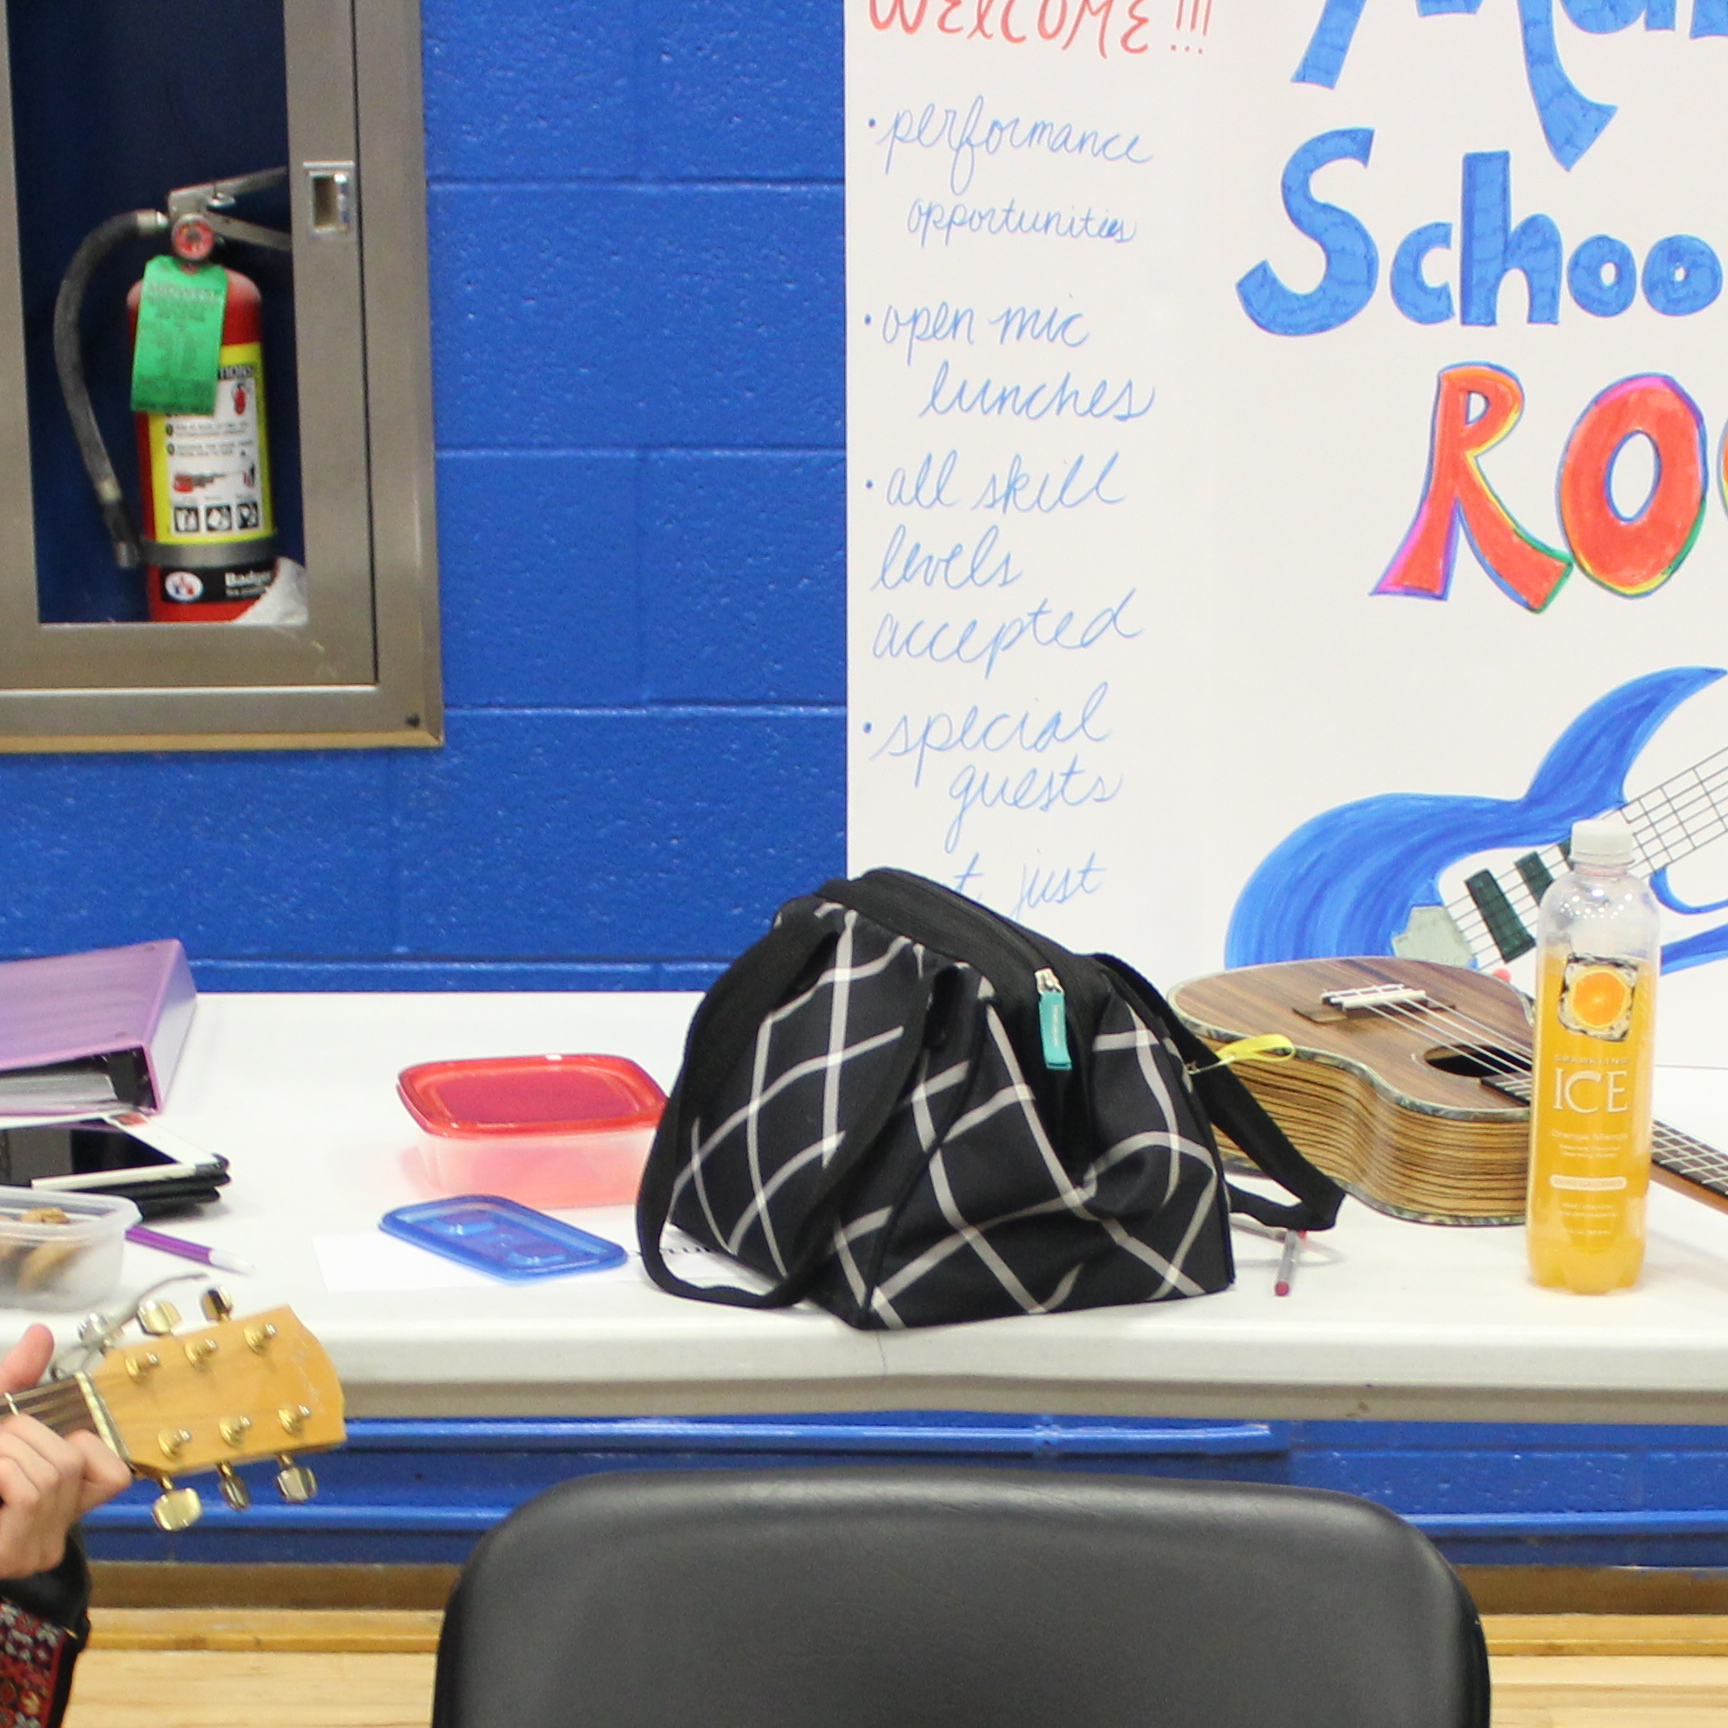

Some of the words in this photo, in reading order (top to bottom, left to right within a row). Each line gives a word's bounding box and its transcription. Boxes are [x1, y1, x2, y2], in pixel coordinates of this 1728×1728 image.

[875, 95, 1154, 195] performance
[906, 199, 1137, 248] opportunities
[880, 302, 976, 365] open
[989, 294, 1091, 348] mic
[917, 360, 1156, 423] lunches
[885, 449, 960, 508] all
[969, 451, 1126, 512] skill
[870, 525, 1024, 591] levels
[871, 587, 1144, 678] accepted
[870, 680, 1114, 787] special
[943, 752, 1124, 854] guests
[1008, 848, 1109, 921] just
[1552, 1066, 1629, 1114] ICE
